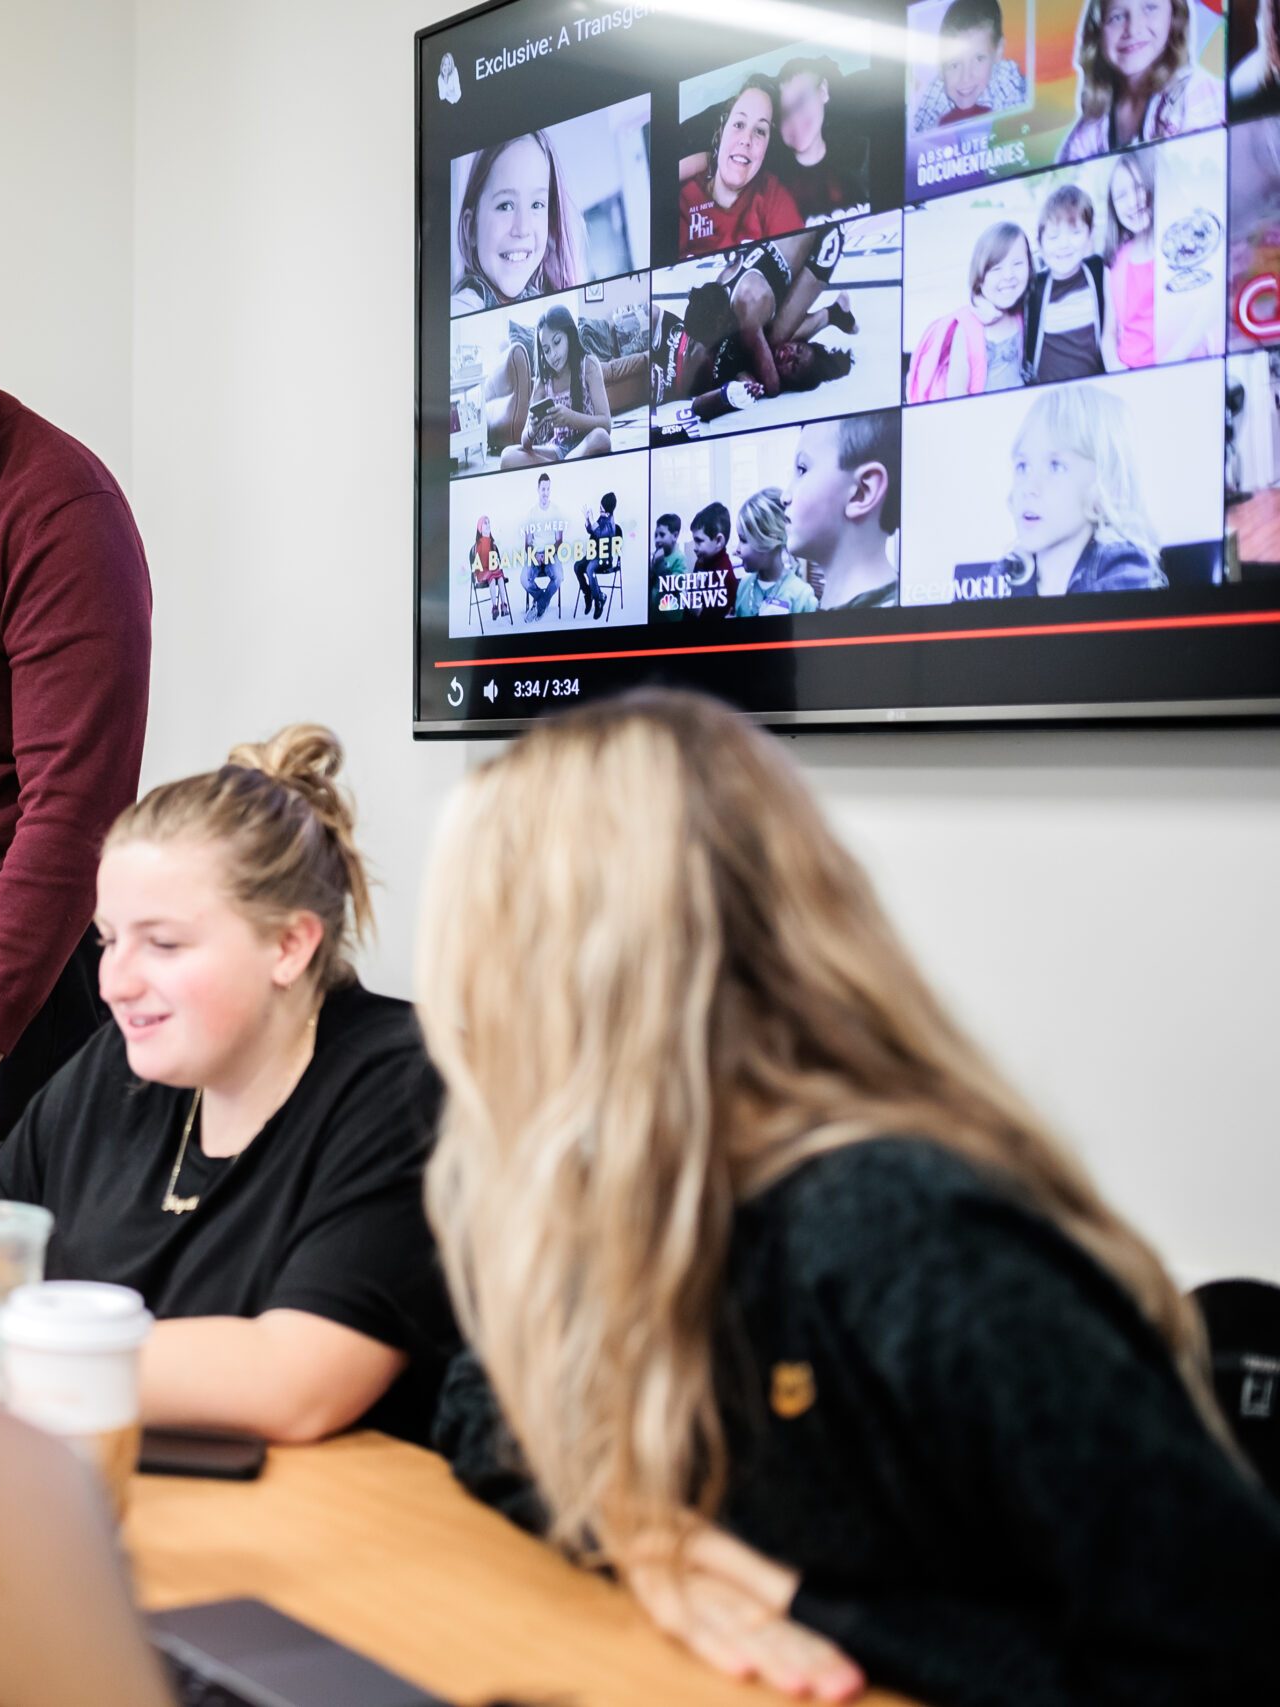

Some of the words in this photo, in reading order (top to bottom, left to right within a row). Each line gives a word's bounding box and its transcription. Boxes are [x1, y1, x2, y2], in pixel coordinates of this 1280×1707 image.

[476, 36, 553, 80] Exclusive:
[557, 26, 570, 49] A
[918, 136, 988, 165] ABSOLUTE
[917, 142, 1025, 186] DOCUMENTARIES
[690, 220, 713, 240] Phil
[544, 520, 569, 532] MEET
[472, 552, 483, 572] A
[489, 546, 539, 570] BANK
[544, 536, 623, 566] ROBBER
[659, 570, 728, 592] NIGHTLY
[679, 588, 728, 610] NEWS
[514, 680, 540, 697] 3:34
[552, 678, 580, 696] 3:34
